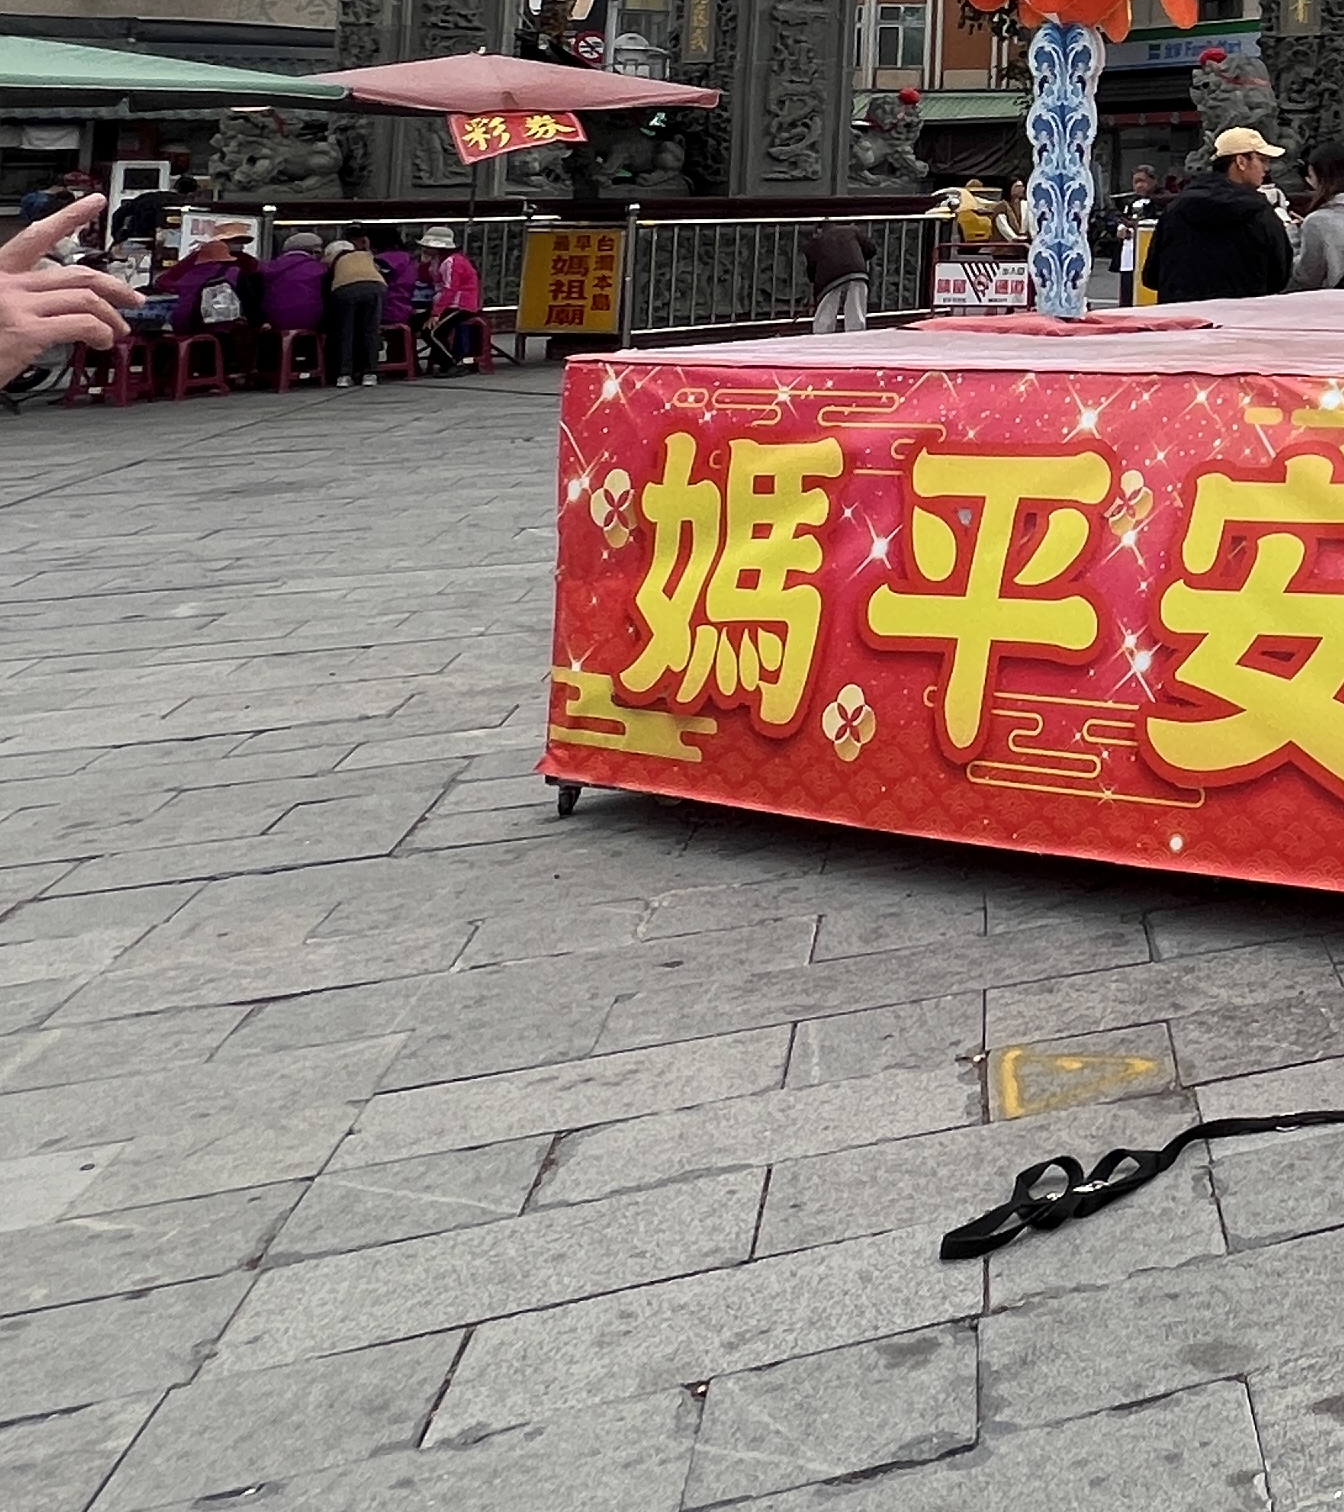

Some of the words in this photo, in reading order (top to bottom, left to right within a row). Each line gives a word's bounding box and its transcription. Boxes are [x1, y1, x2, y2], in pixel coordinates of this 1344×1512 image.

[462, 114, 576, 150] 彩券
[545, 254, 592, 325] 媽祖廟
